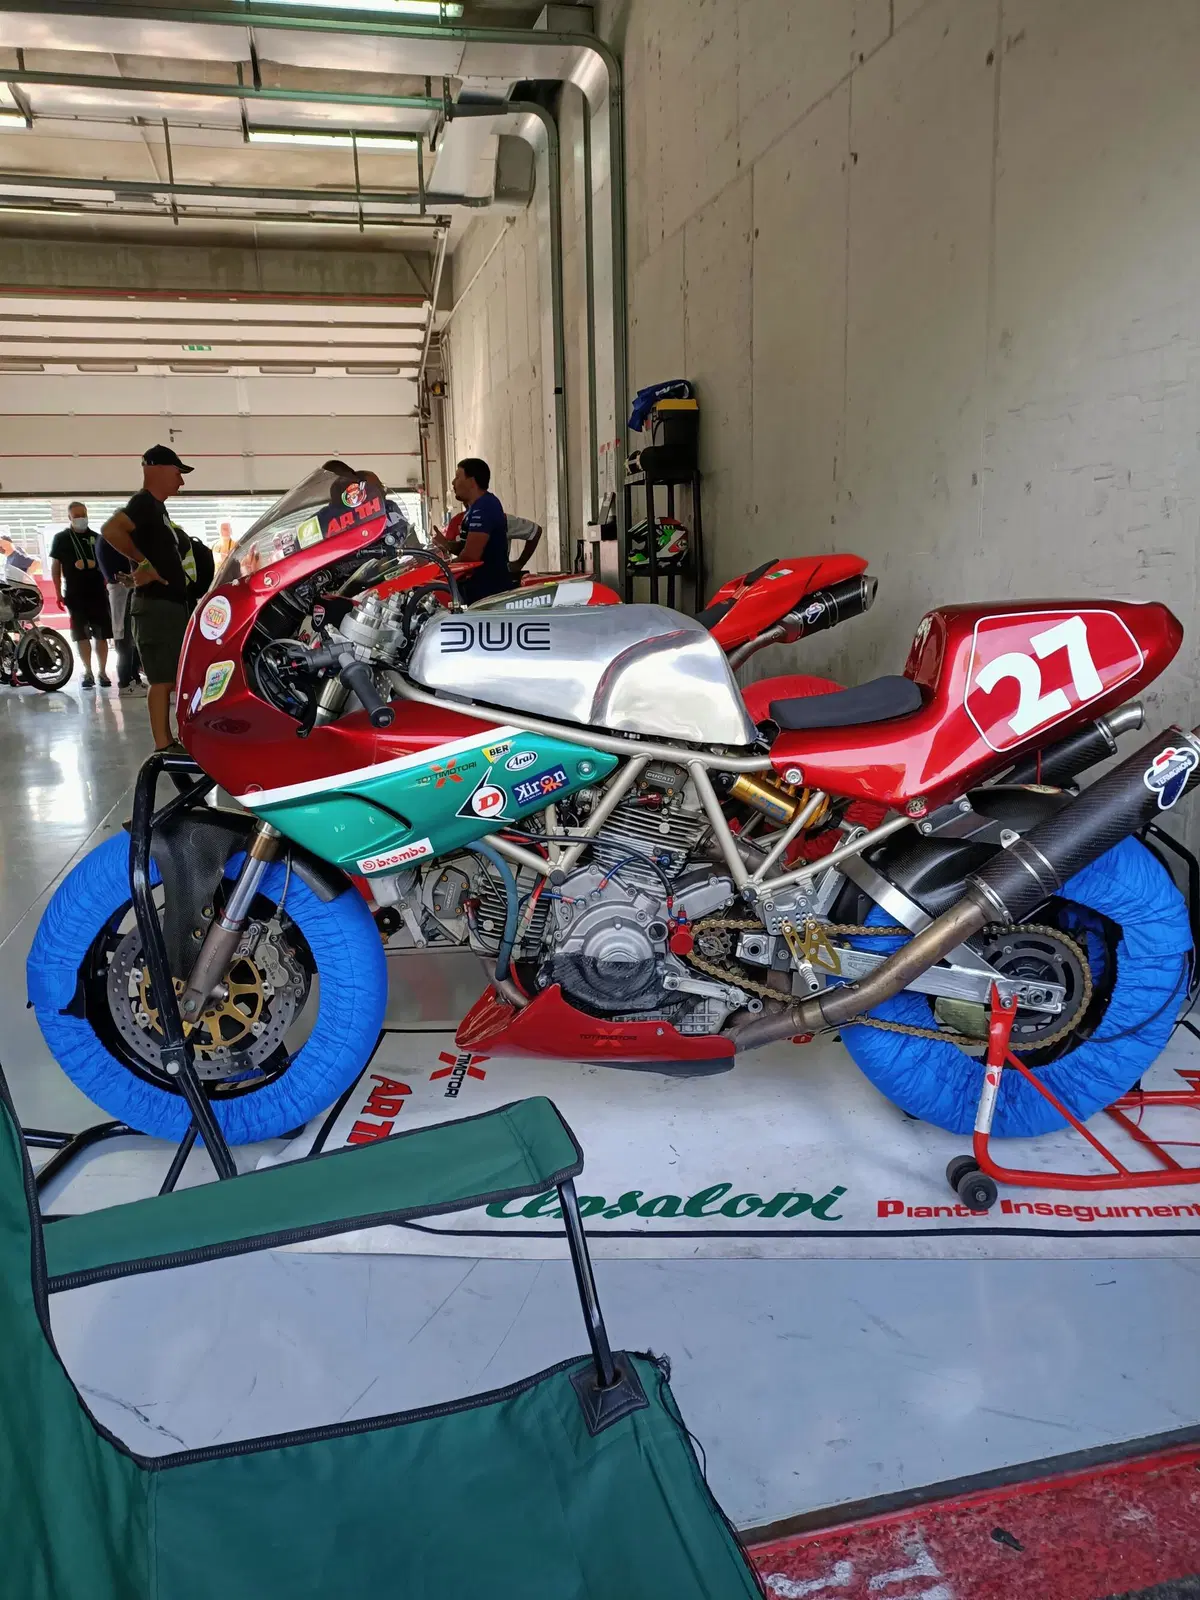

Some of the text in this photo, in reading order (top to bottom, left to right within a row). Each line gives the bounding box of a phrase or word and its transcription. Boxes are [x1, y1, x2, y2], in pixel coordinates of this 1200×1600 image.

[505, 594, 551, 610] DUCATI
[440, 622, 550, 653] DUC
[975, 616, 1104, 736] 27
[488, 743, 510, 757] BER
[511, 755, 533, 766] Arai
[1156, 758, 1193, 786] TERMIGNONI
[478, 792, 500, 812] D
[377, 846, 427, 868] brembo
